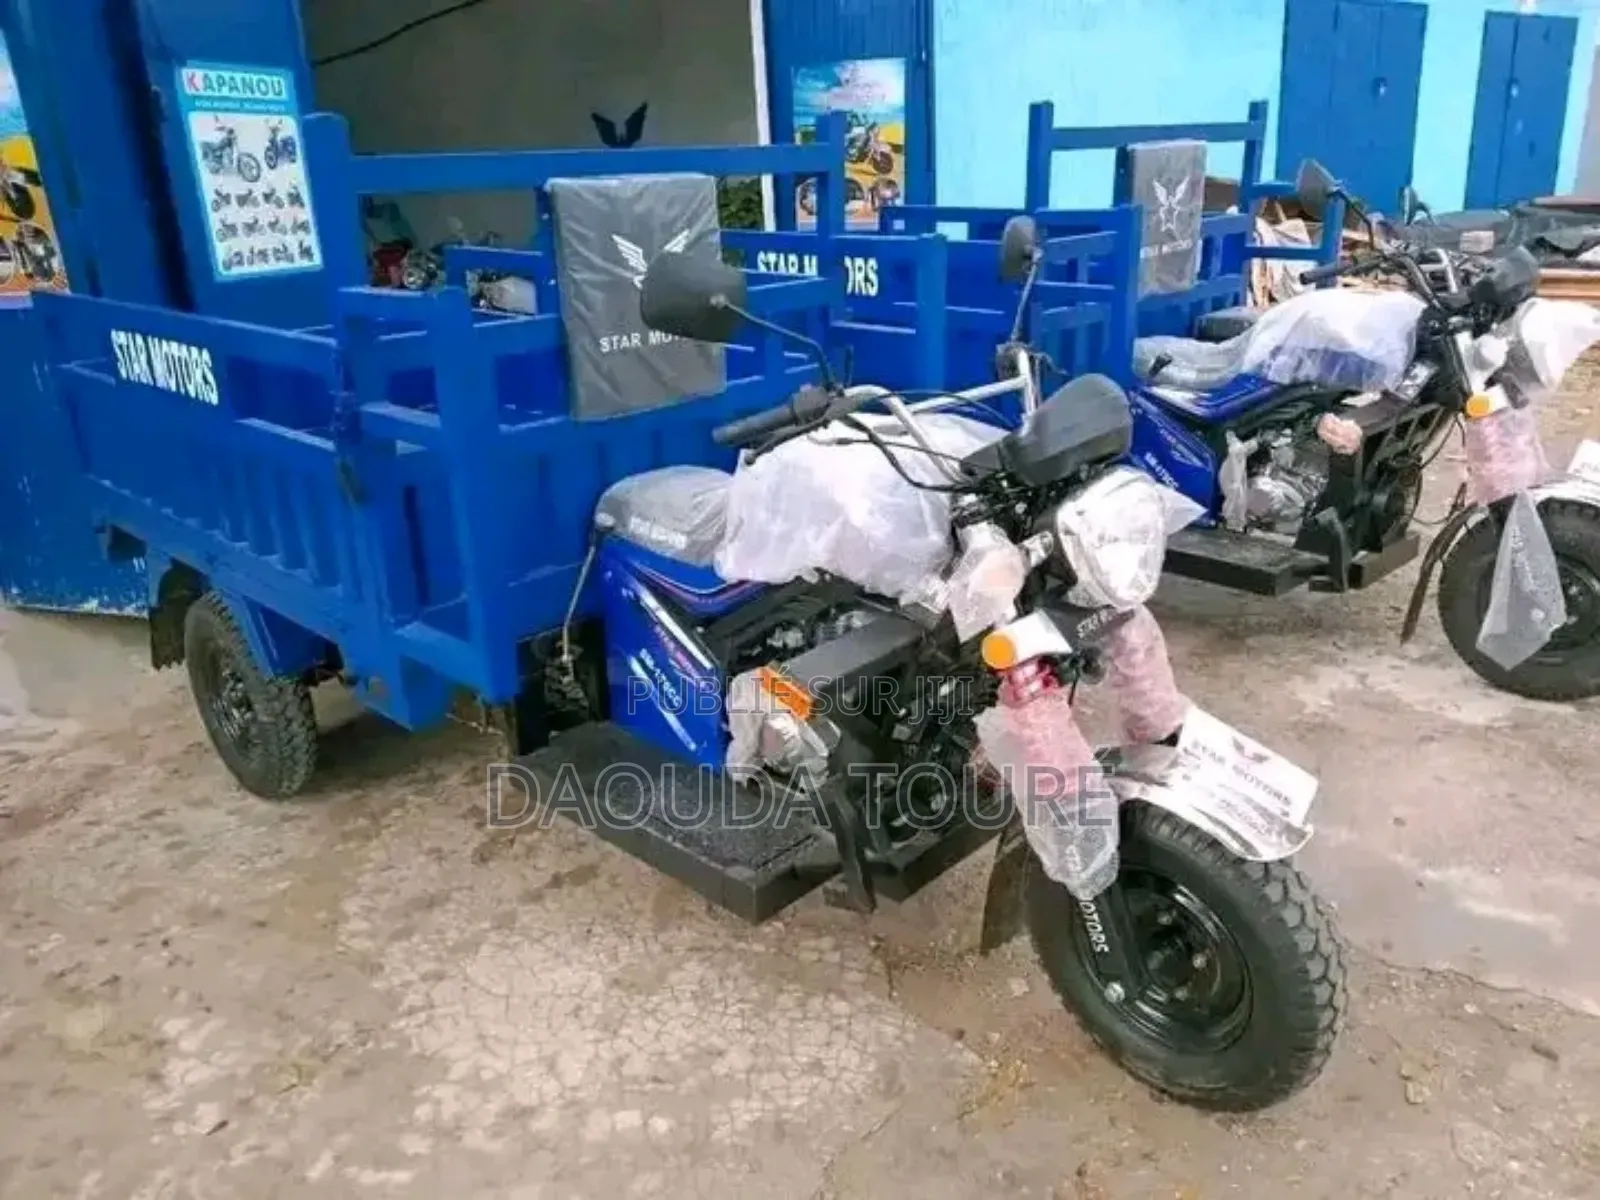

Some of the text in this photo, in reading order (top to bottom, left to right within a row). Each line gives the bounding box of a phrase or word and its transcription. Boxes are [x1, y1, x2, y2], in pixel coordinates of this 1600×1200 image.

[186, 70, 284, 97] KAPANOU
[599, 331, 642, 354] STAR
[110, 328, 219, 406] STAR MOTORS
